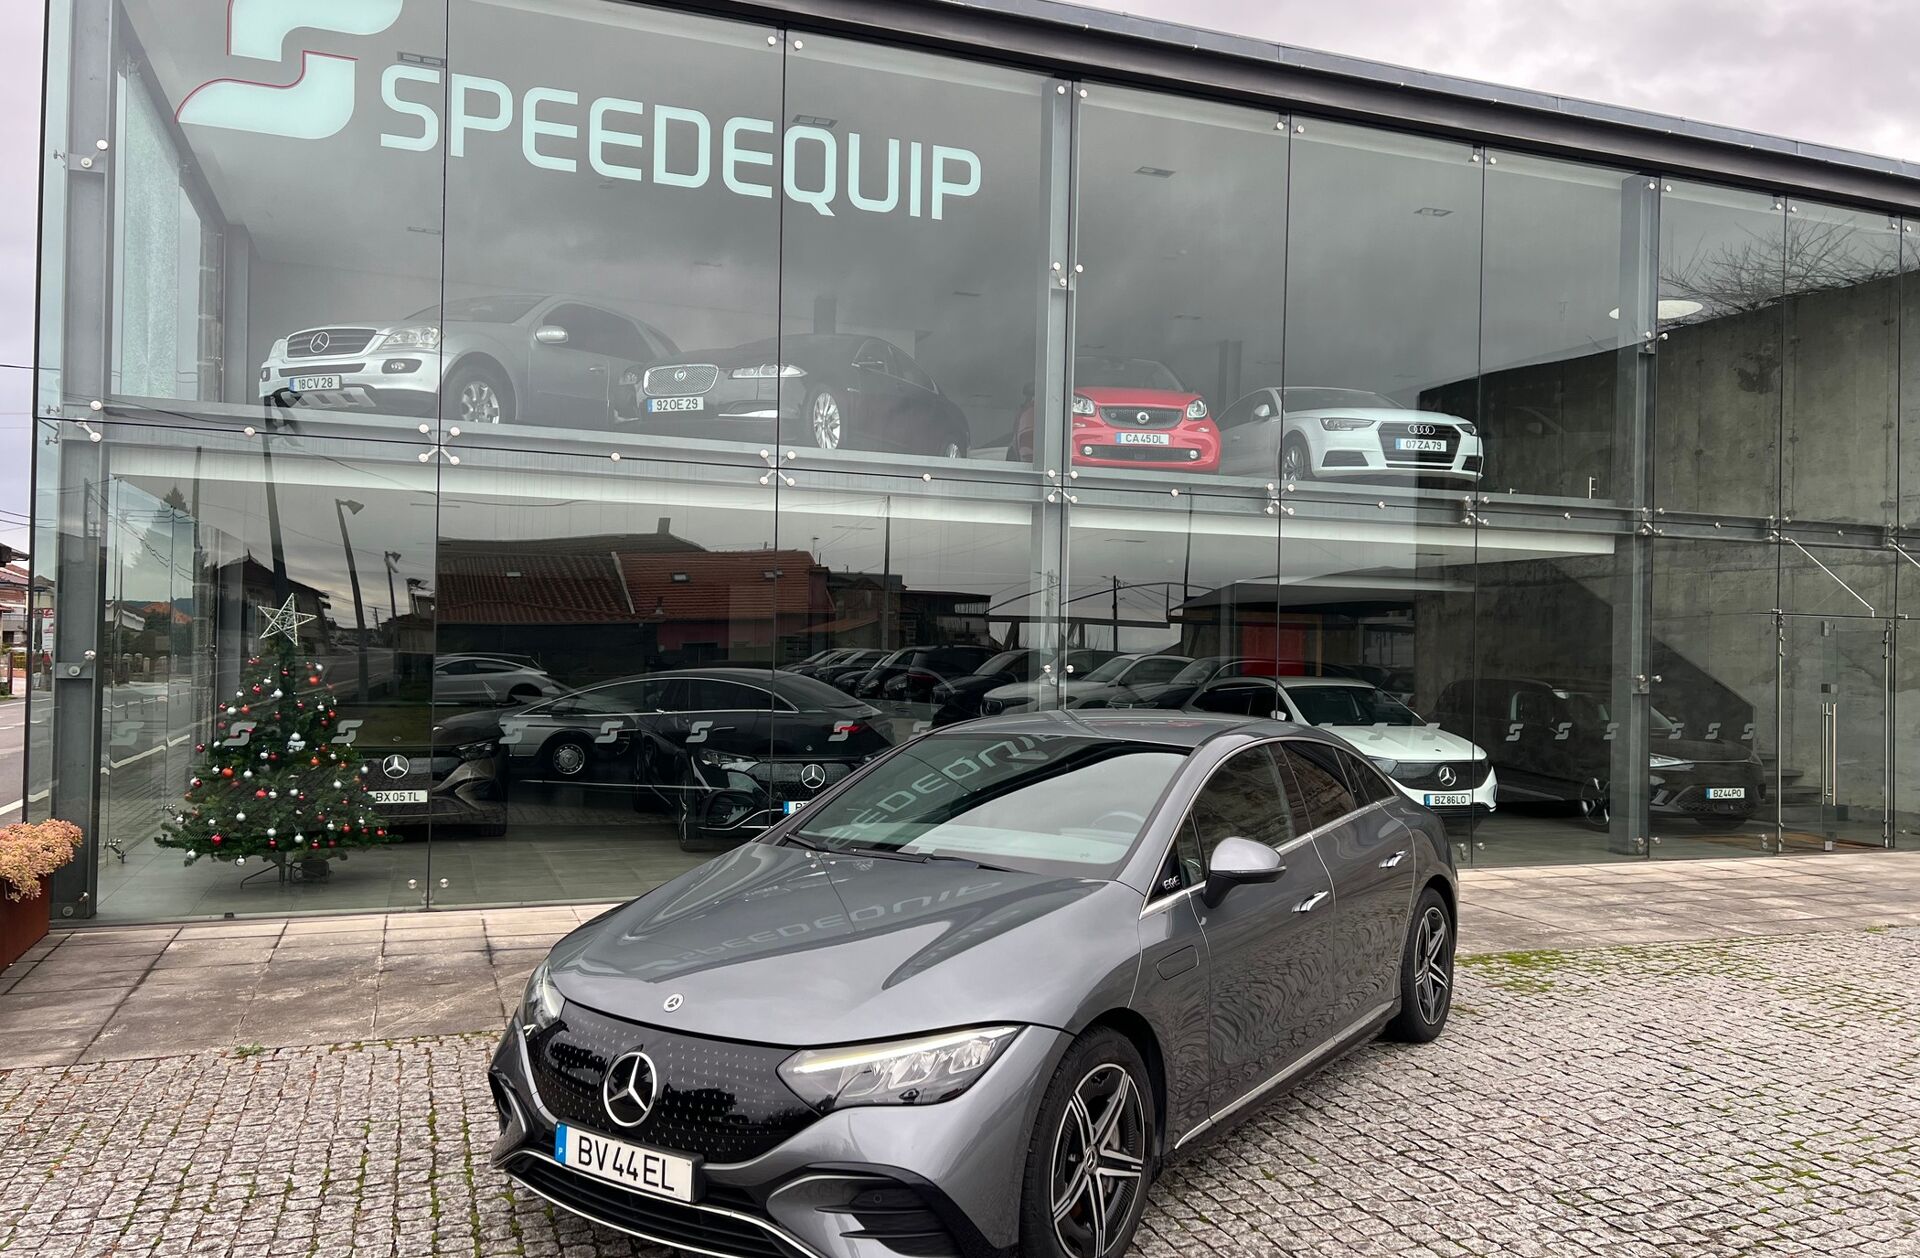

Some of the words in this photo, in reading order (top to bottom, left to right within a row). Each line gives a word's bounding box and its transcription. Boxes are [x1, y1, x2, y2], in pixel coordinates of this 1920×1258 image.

[380, 64, 982, 220] SPEEDEQUIP
[1125, 433, 1165, 444] CA45DL
[1405, 440, 1442, 450] 07ZA79
[375, 791, 420, 802] BX05TL
[577, 1135, 675, 1192] BV44EL
